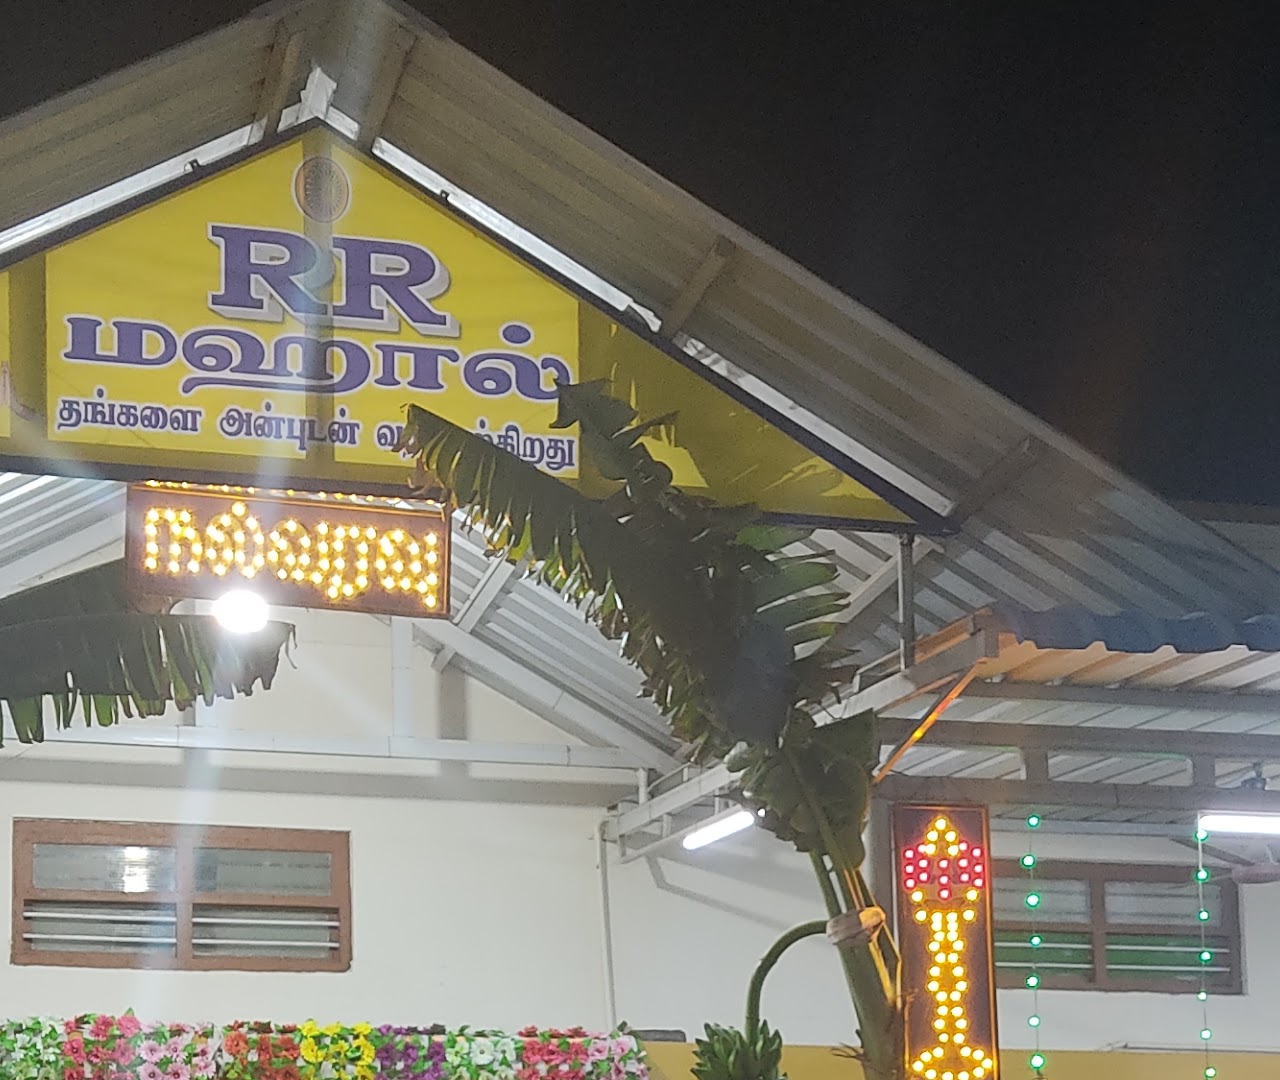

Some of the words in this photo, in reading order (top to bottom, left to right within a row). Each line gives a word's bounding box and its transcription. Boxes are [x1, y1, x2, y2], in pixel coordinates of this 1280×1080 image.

[209, 224, 453, 331] RR
[63, 316, 572, 401] மஹால்
[57, 387, 203, 433] தங்களை
[219, 401, 361, 451] அன்புடன்
[144, 500, 440, 610] நல்வரவு
